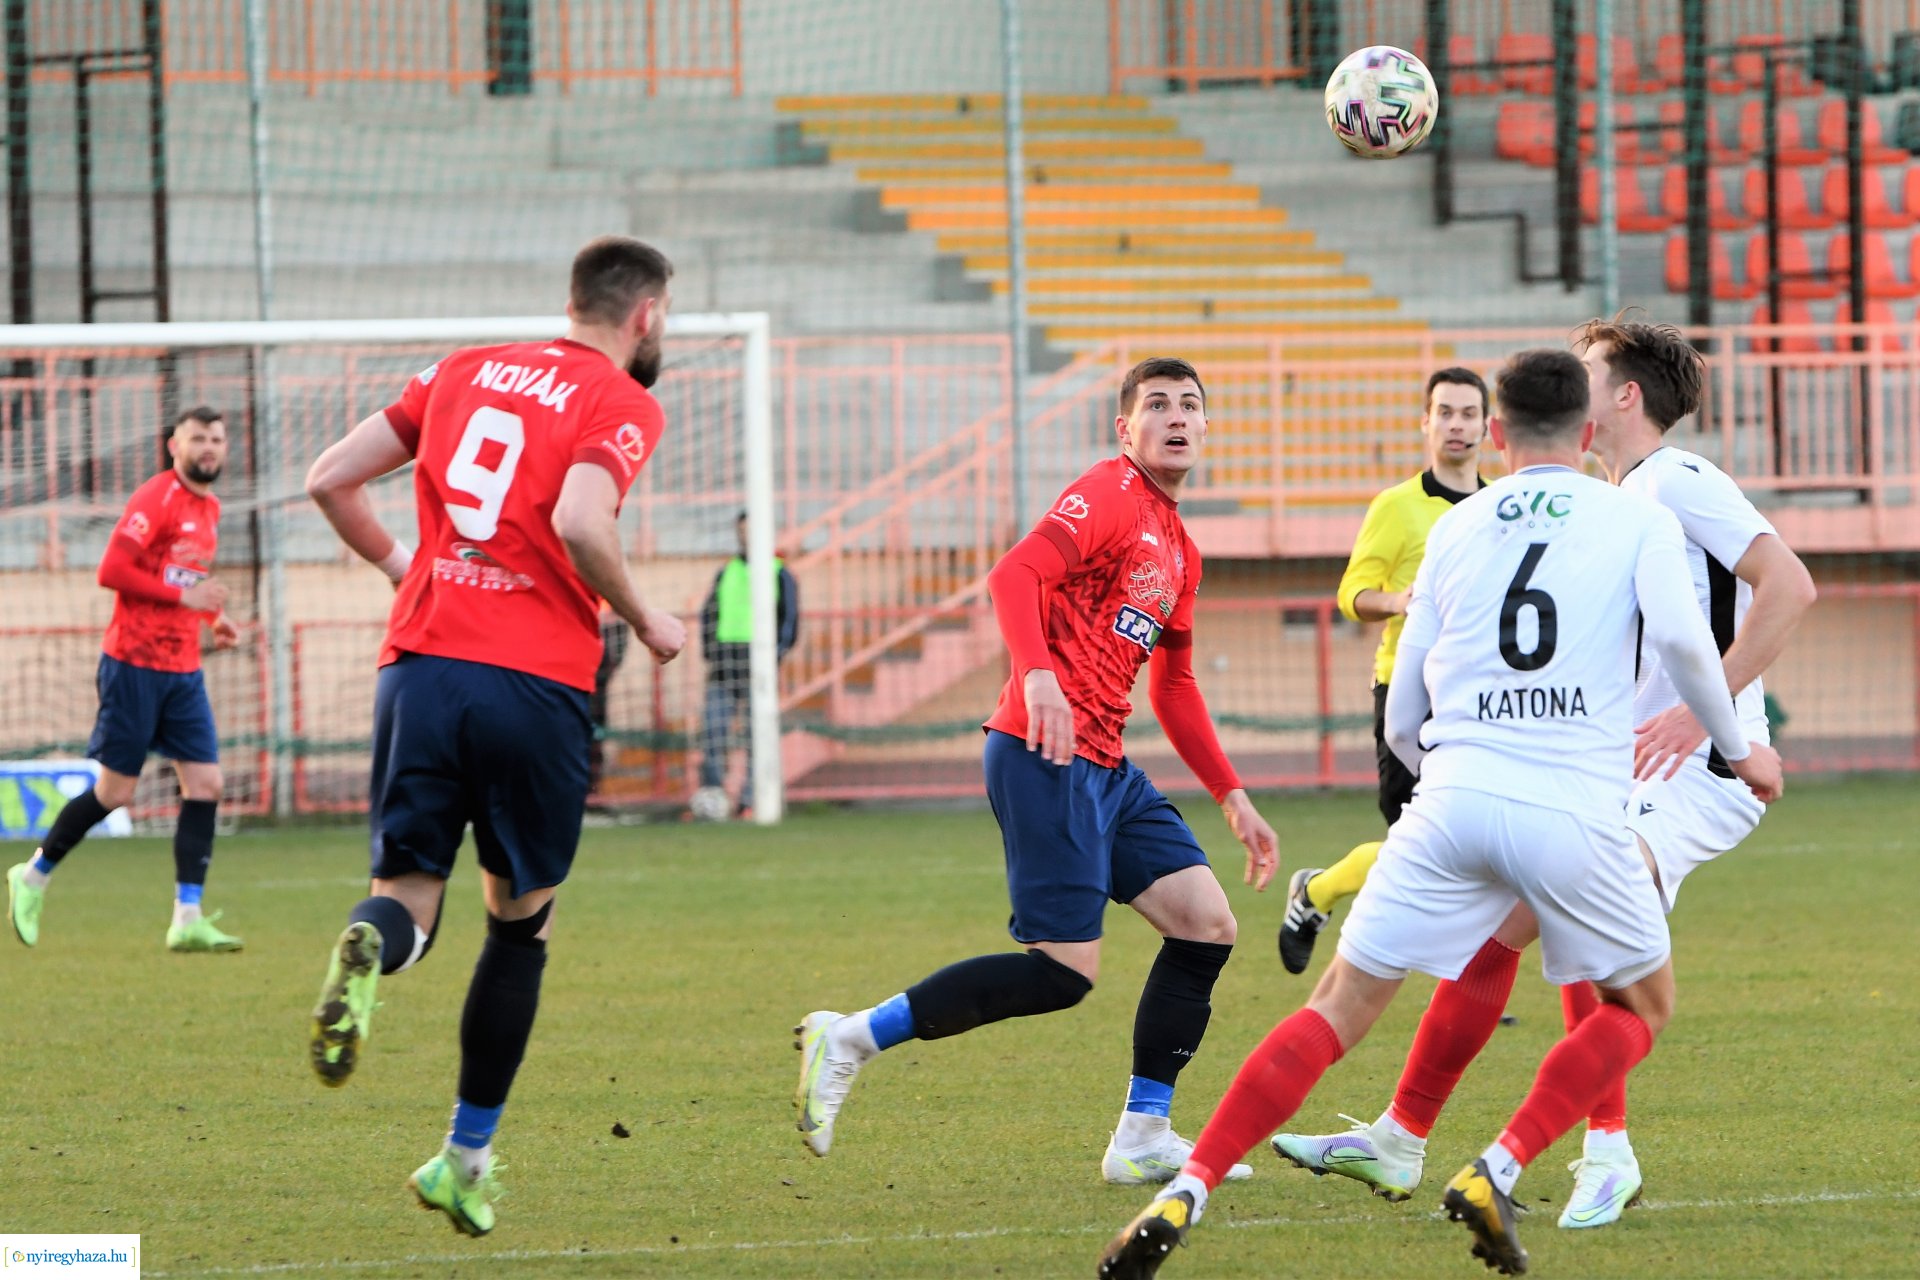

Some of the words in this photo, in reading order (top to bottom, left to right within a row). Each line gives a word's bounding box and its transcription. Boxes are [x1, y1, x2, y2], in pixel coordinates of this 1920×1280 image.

[472, 360, 578, 413] NOVÁK
[446, 405, 525, 541] 9
[1499, 543, 1558, 671] 6
[1478, 686, 1588, 720] KATONA
